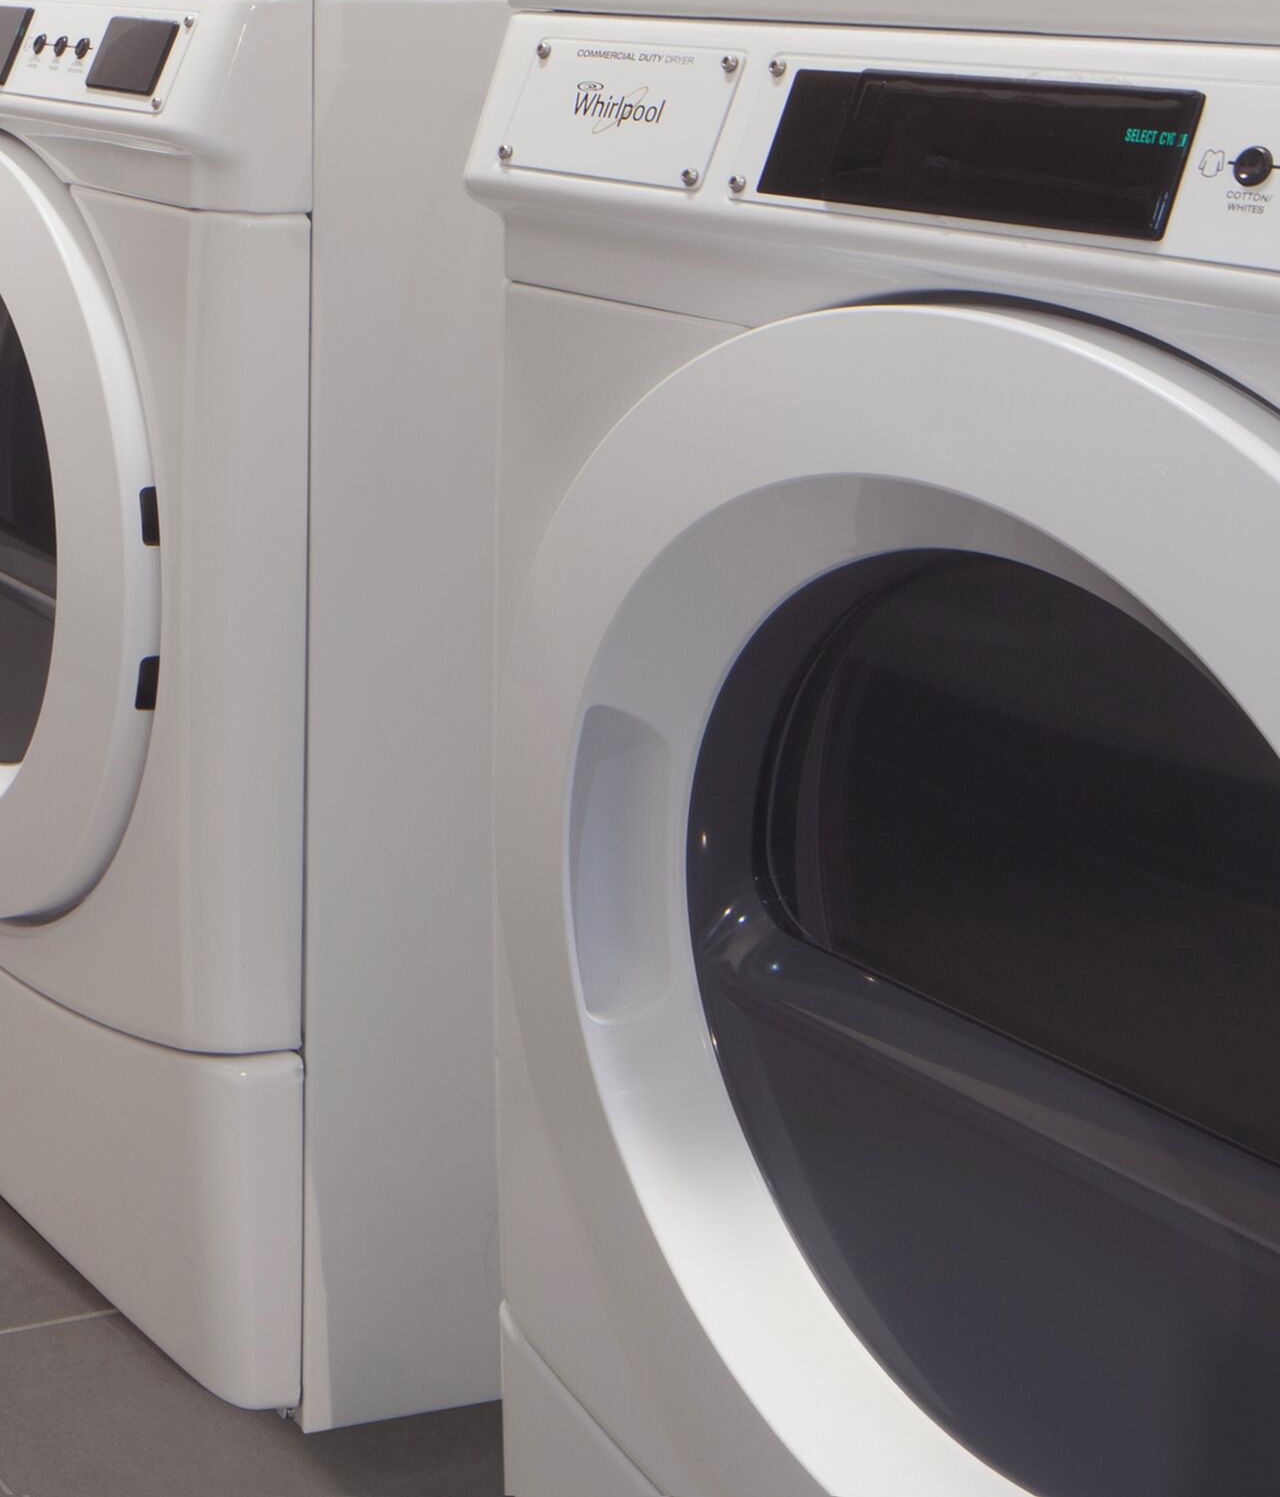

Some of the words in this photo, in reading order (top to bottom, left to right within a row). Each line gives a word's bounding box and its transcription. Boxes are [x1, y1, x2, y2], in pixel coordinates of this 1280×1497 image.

[576, 49, 636, 61] COMMERCIAL
[638, 53, 664, 63] DUTY
[664, 55, 695, 65] DRYER
[574, 91, 666, 127] Whirlpool
[1124, 128, 1158, 144] SELECT
[1226, 191, 1273, 202] COTTON/
[1227, 203, 1265, 214] WHITES
